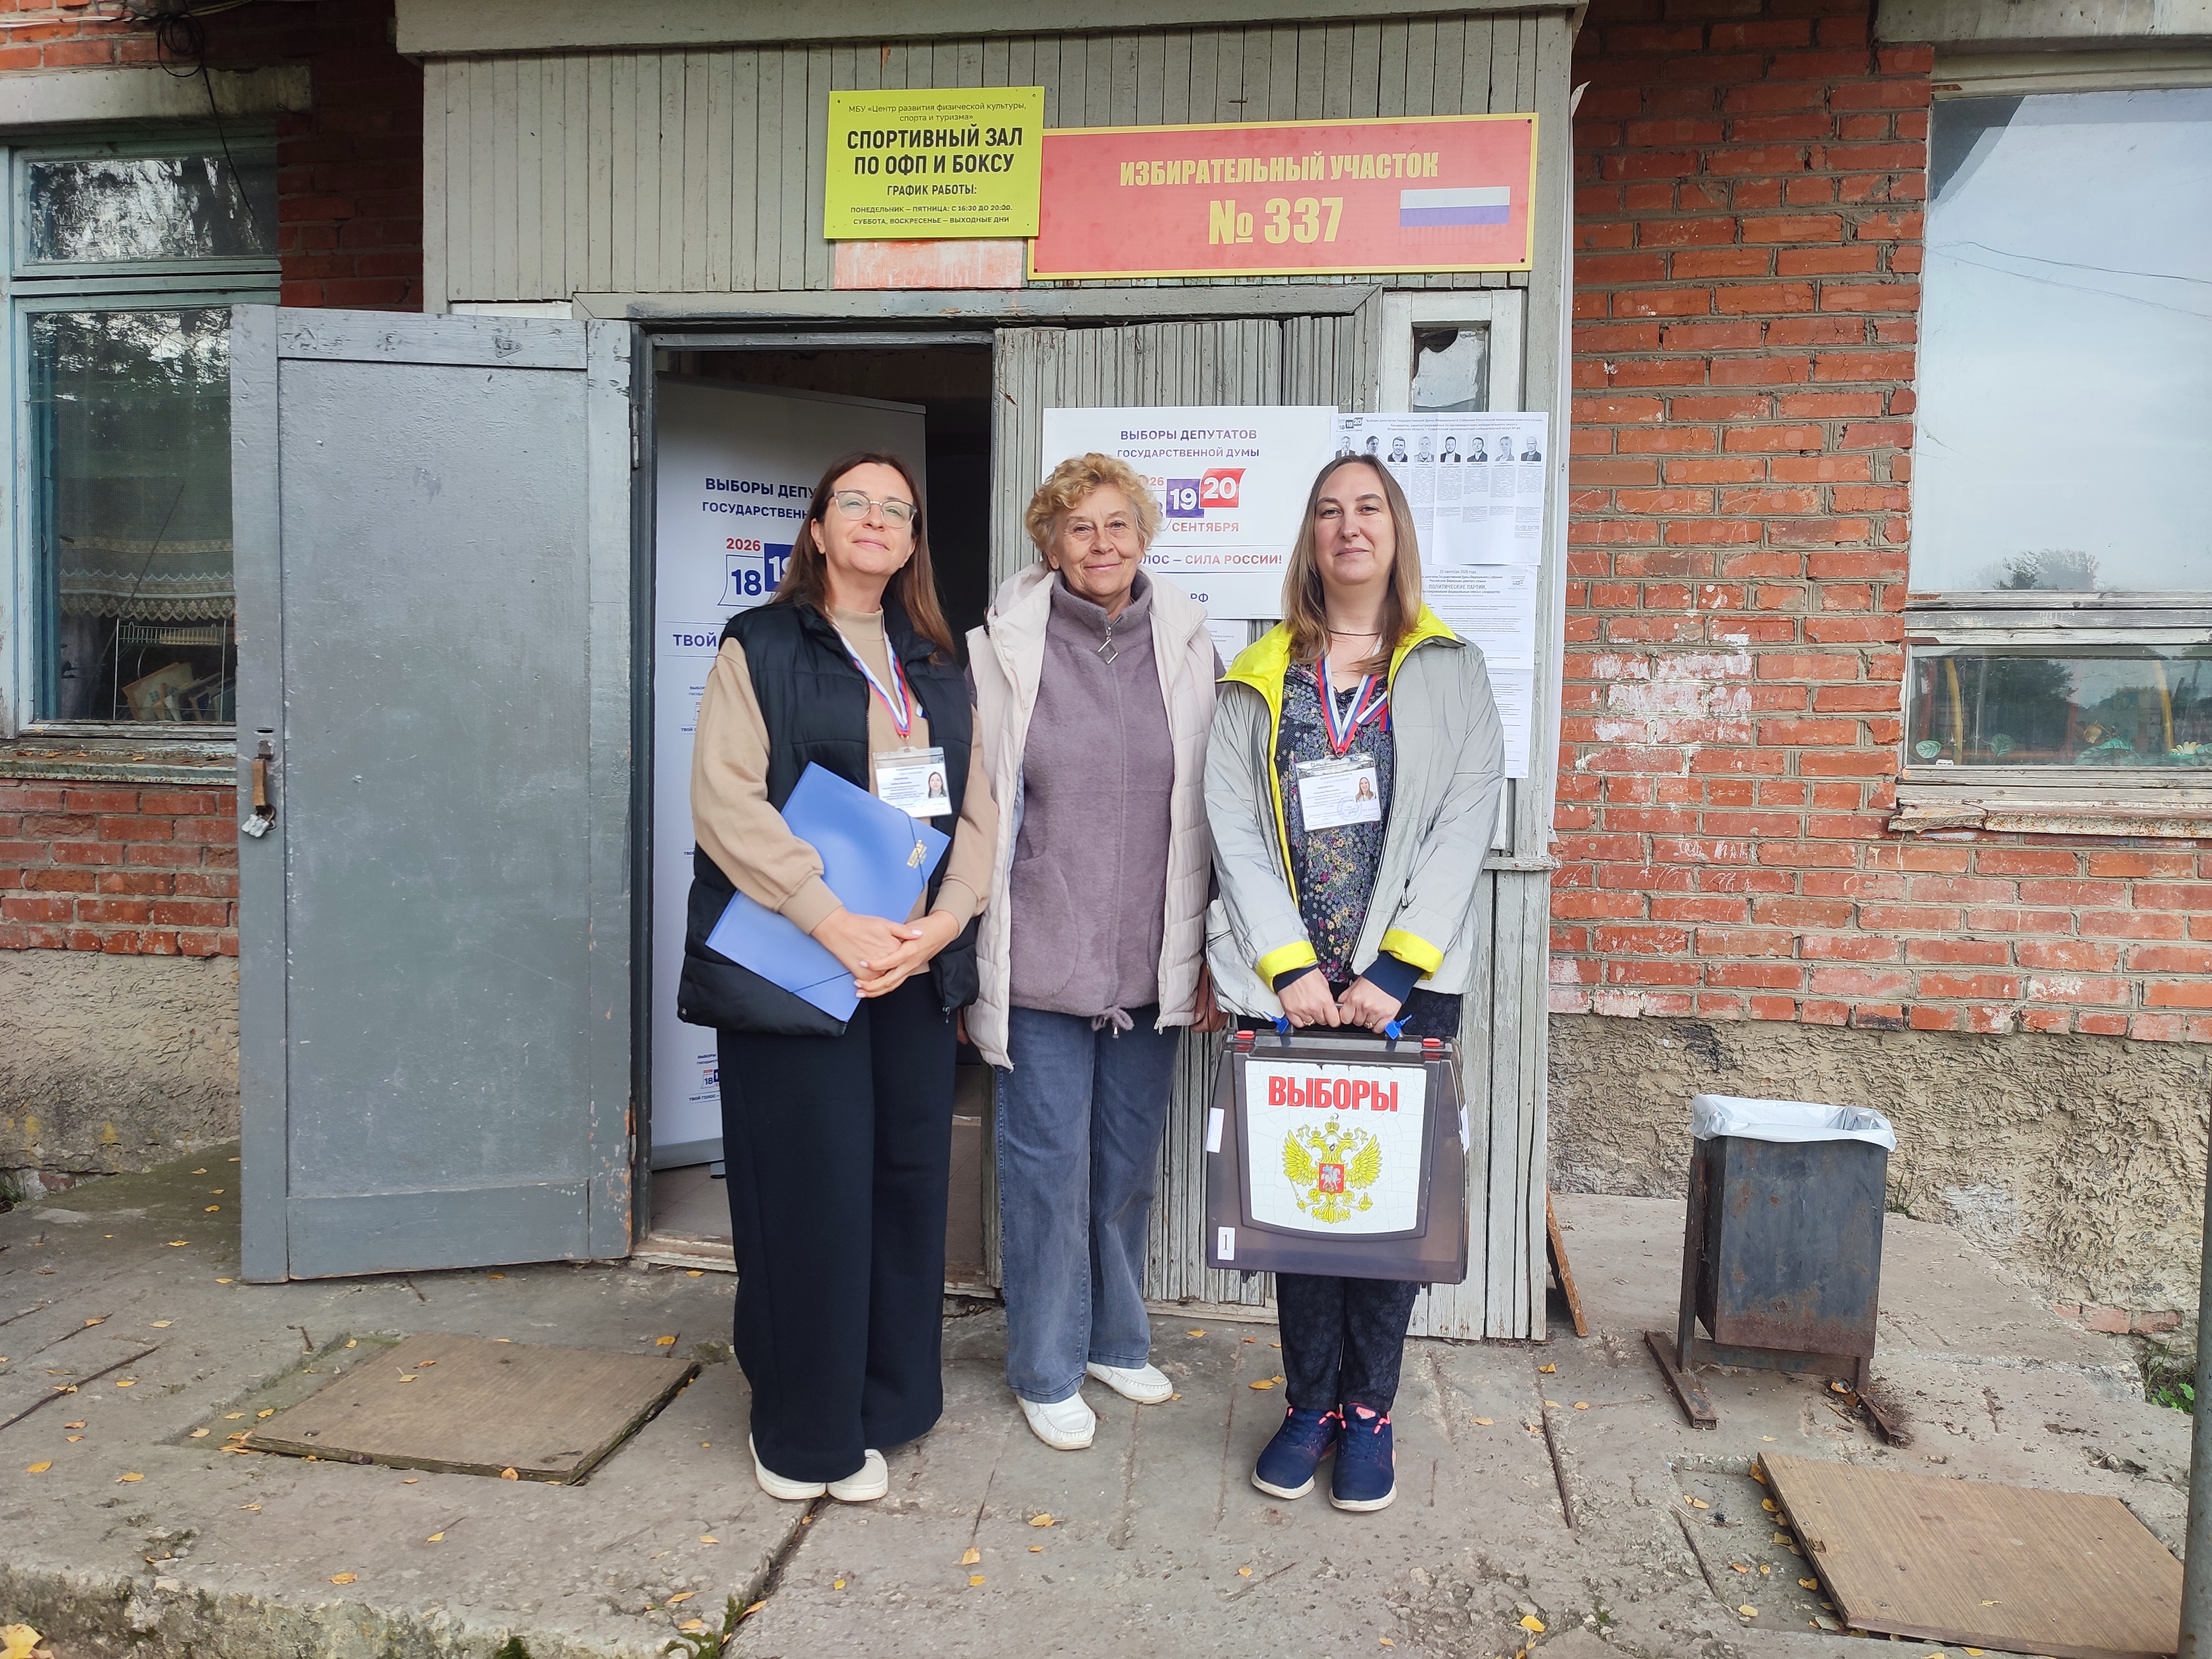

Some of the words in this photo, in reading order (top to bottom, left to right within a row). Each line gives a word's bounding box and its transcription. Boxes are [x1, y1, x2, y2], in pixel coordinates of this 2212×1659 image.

[936, 103, 985, 112] физической
[987, 102, 1027, 111] культуры,
[847, 123, 979, 149] СПОРТИВНЫЙ
[984, 127, 1022, 147] ЗАЛ
[854, 156, 879, 175] ПО
[885, 154, 927, 175] ОФП
[933, 155, 946, 174] И
[952, 153, 1015, 174] БОКСУ
[1120, 151, 1325, 186] ИЗБИРАТЕЛЬНЫЙ
[1330, 152, 1439, 181] УЧАСТОК
[887, 184, 929, 196] ГРАФИК
[932, 184, 978, 195] РАБОТЫ:
[1209, 200, 1254, 244] №
[1264, 197, 1344, 243] 337
[1120, 430, 1177, 441] ВЫБОРЫ
[1180, 429, 1258, 441] ДЕПУТАТОВ
[1117, 447, 1224, 458] ГОСУДАРСТВЕННОЙ
[1226, 448, 1260, 459] ДУМЫ
[705, 477, 774, 496] ВЫБОРЫ
[778, 484, 817, 499] ДЕПУ
[1170, 488, 1197, 510] 19
[1203, 477, 1237, 499] 20
[702, 502, 808, 520] ГОСУДАРСТВЕНН
[1172, 522, 1239, 532] СЕНТЯБРЯ
[726, 538, 761, 552] 2026
[1138, 555, 1170, 565] ЛОС
[1185, 555, 1220, 565] СИЛА
[1224, 554, 1282, 565] РОССИИ!
[731, 570, 763, 596] 18
[672, 633, 717, 648] ТВОЙ
[1268, 1076, 1399, 1112] ВЫБОРЫ
[1223, 1233, 1229, 1251] 1
